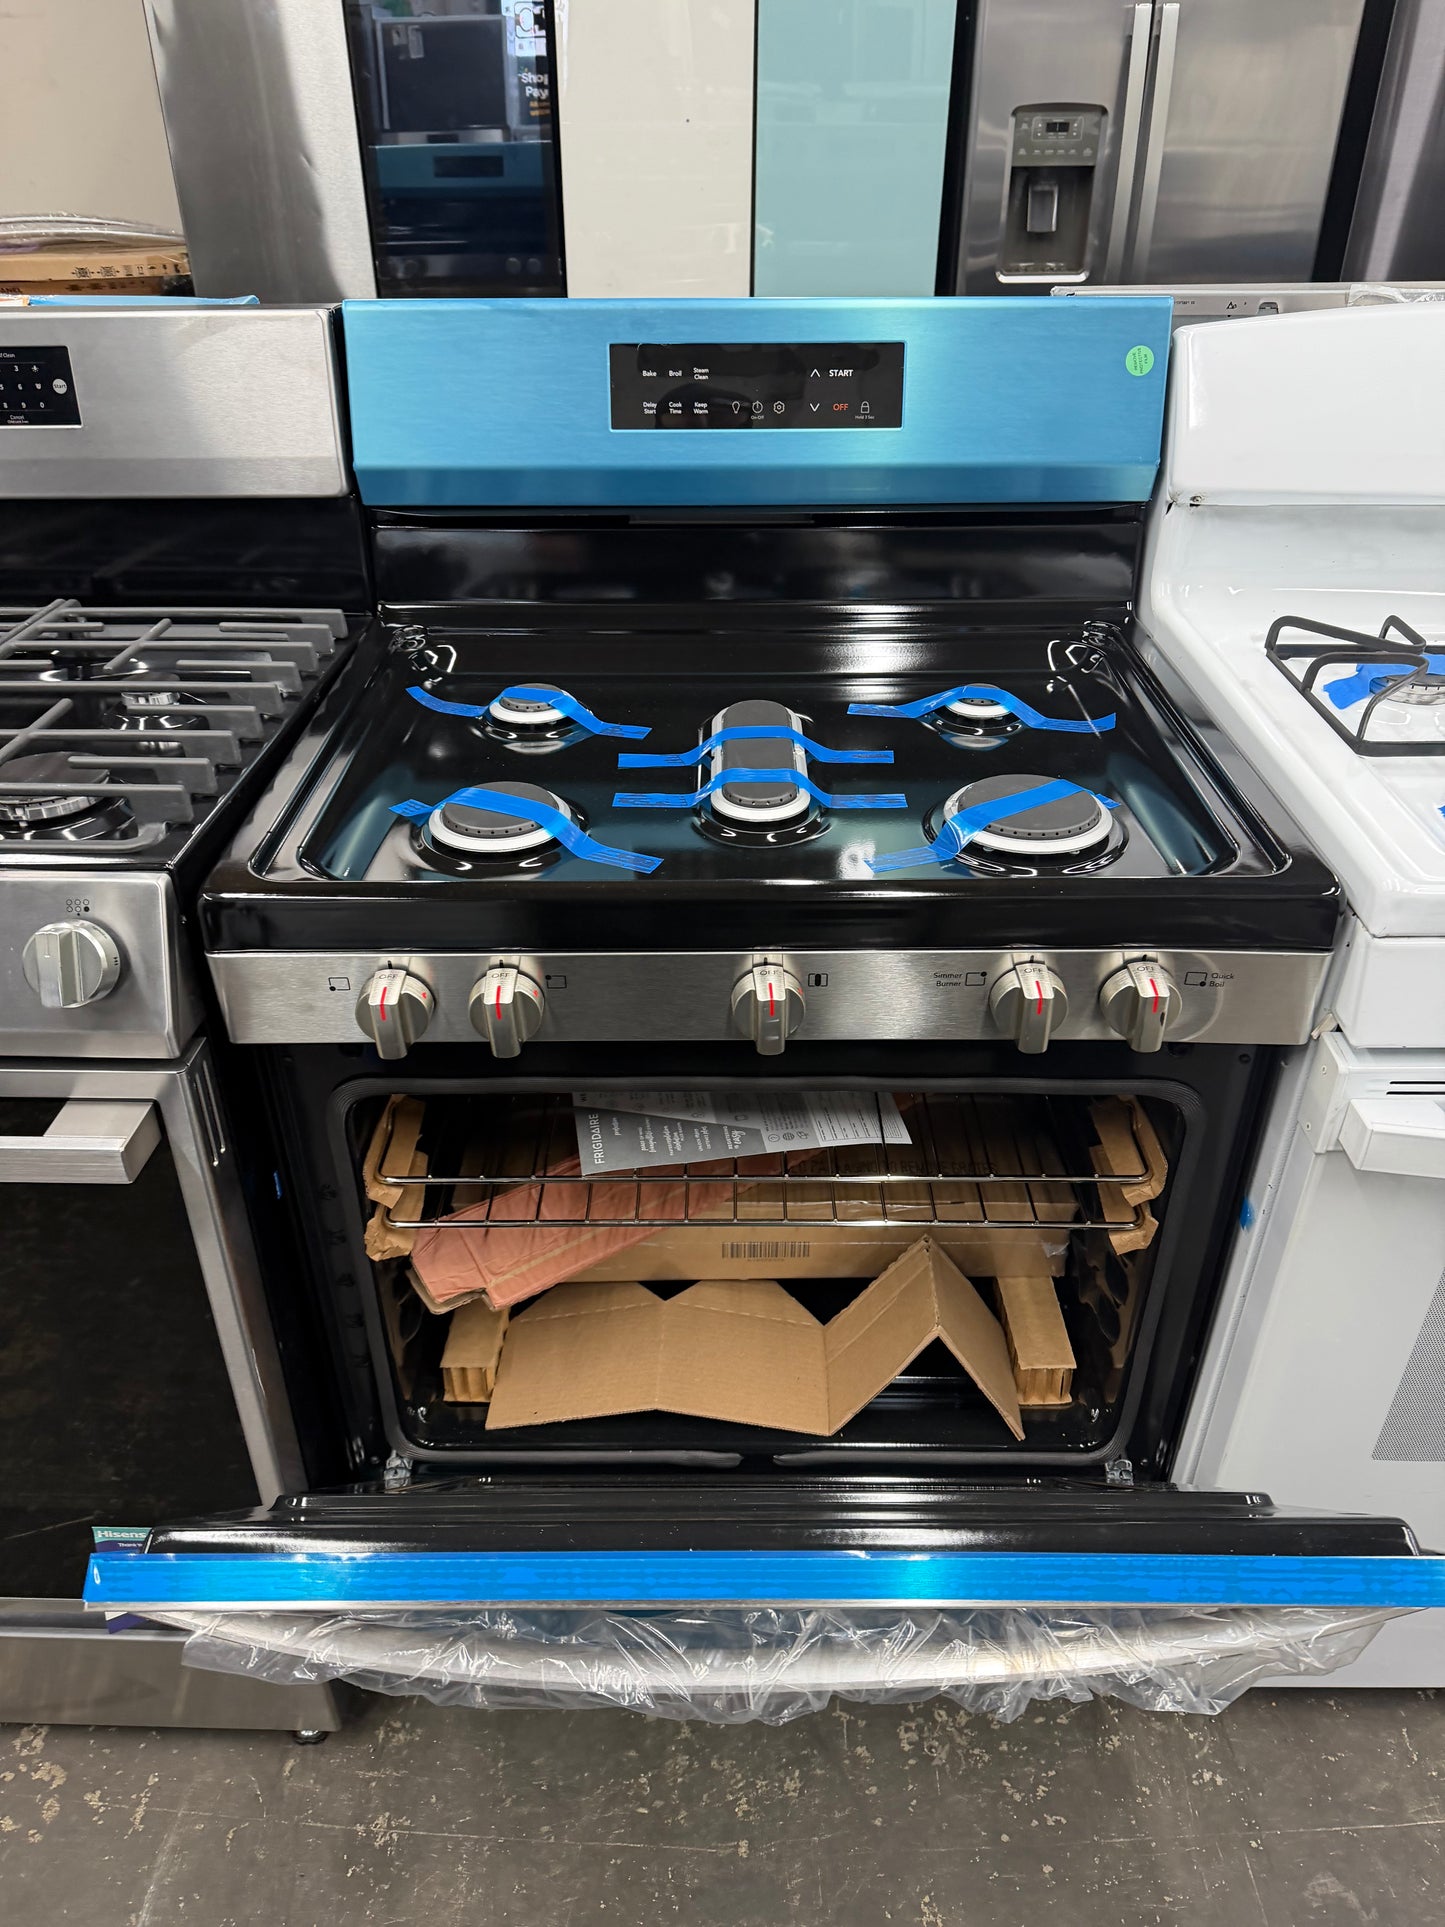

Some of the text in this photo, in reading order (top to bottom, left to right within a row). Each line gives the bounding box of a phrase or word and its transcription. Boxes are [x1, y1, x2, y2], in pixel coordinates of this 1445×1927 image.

[829, 369, 854, 377] START
[642, 401, 657, 409] Delay
[694, 401, 708, 409] Keep
[832, 403, 849, 411] OFF
[1210, 972, 1235, 980] Quick
[588, 1113, 605, 1165] FRIGIDAIRE
[731, 1130, 746, 1145] easy
